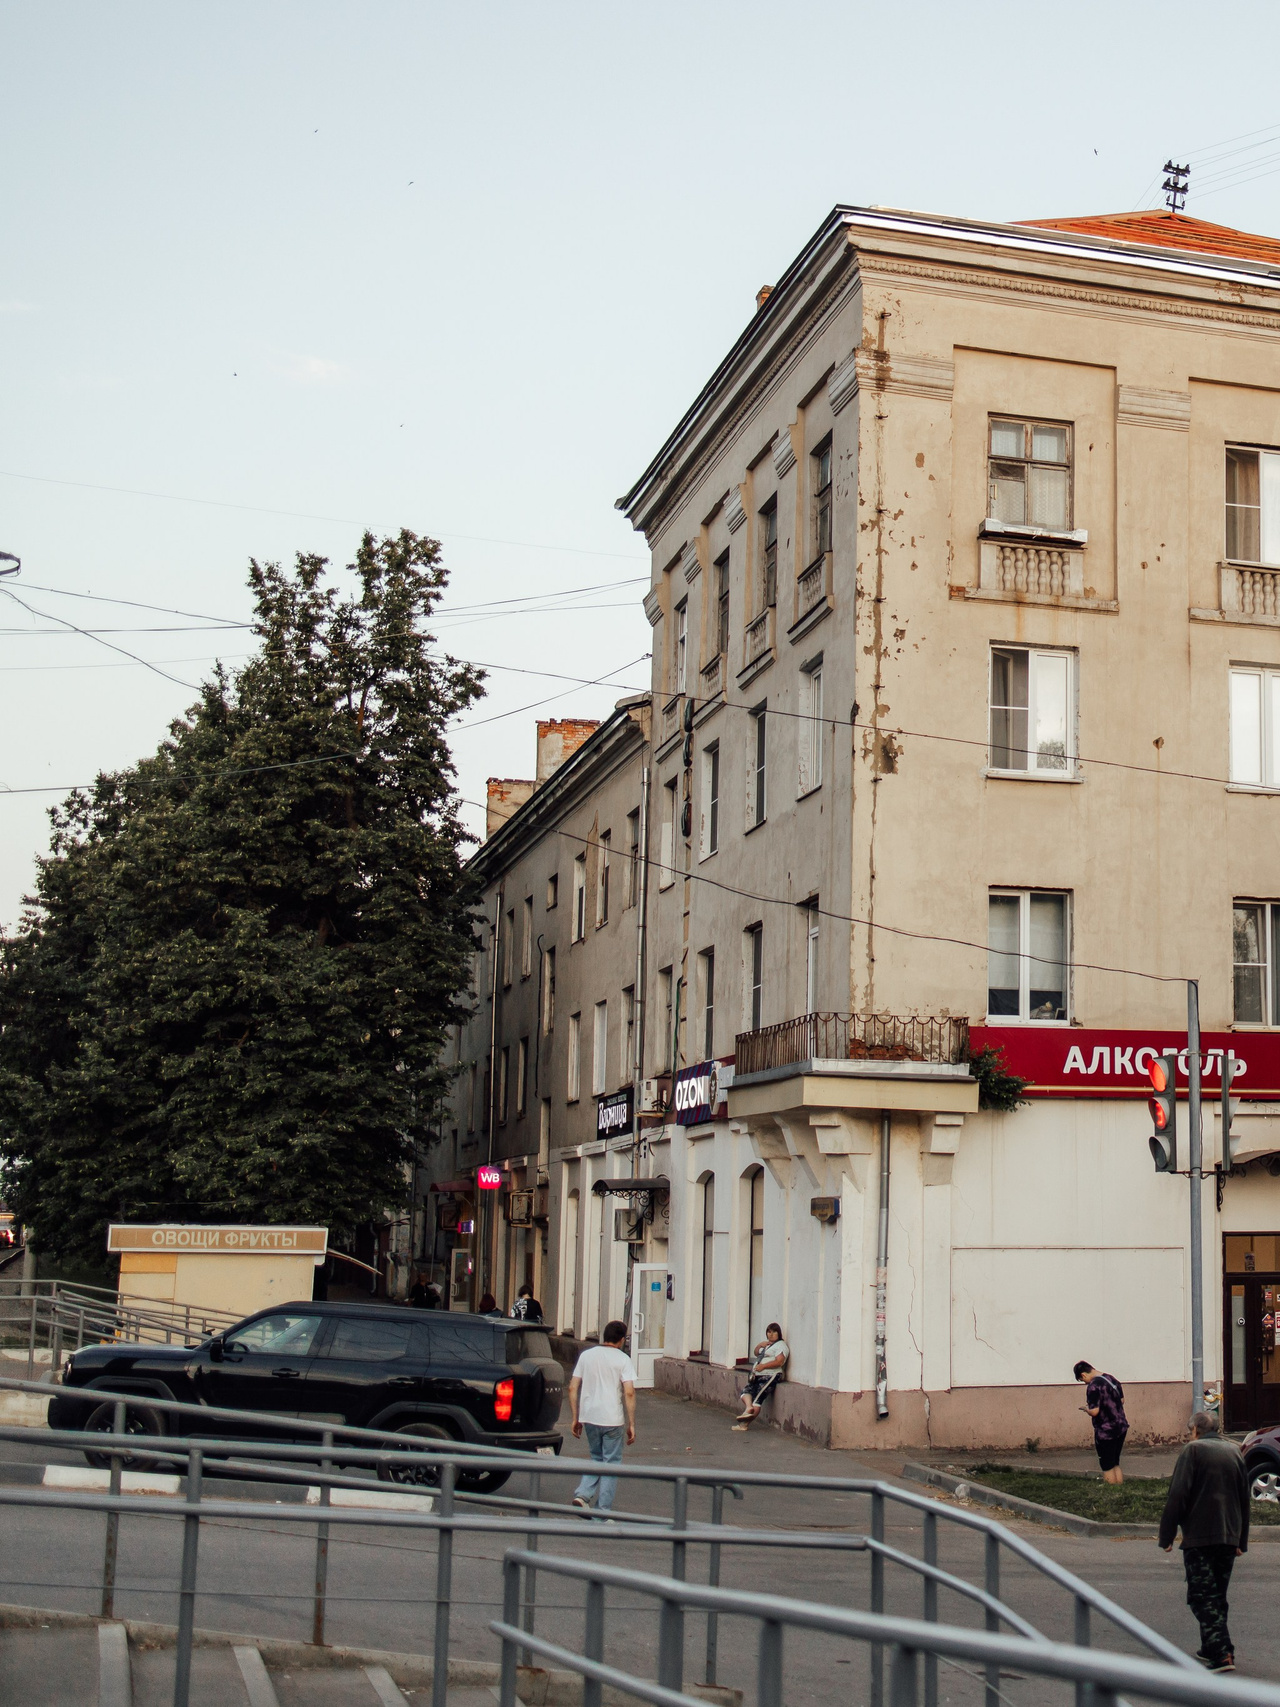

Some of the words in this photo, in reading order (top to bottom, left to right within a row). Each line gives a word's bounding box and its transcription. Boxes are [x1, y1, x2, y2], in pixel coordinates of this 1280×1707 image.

[675, 1076, 708, 1111] OZON
[480, 1172, 500, 1183] WB
[151, 1230, 220, 1248] ОВОЩИ
[224, 1231, 297, 1247] ФРУКТЫ
